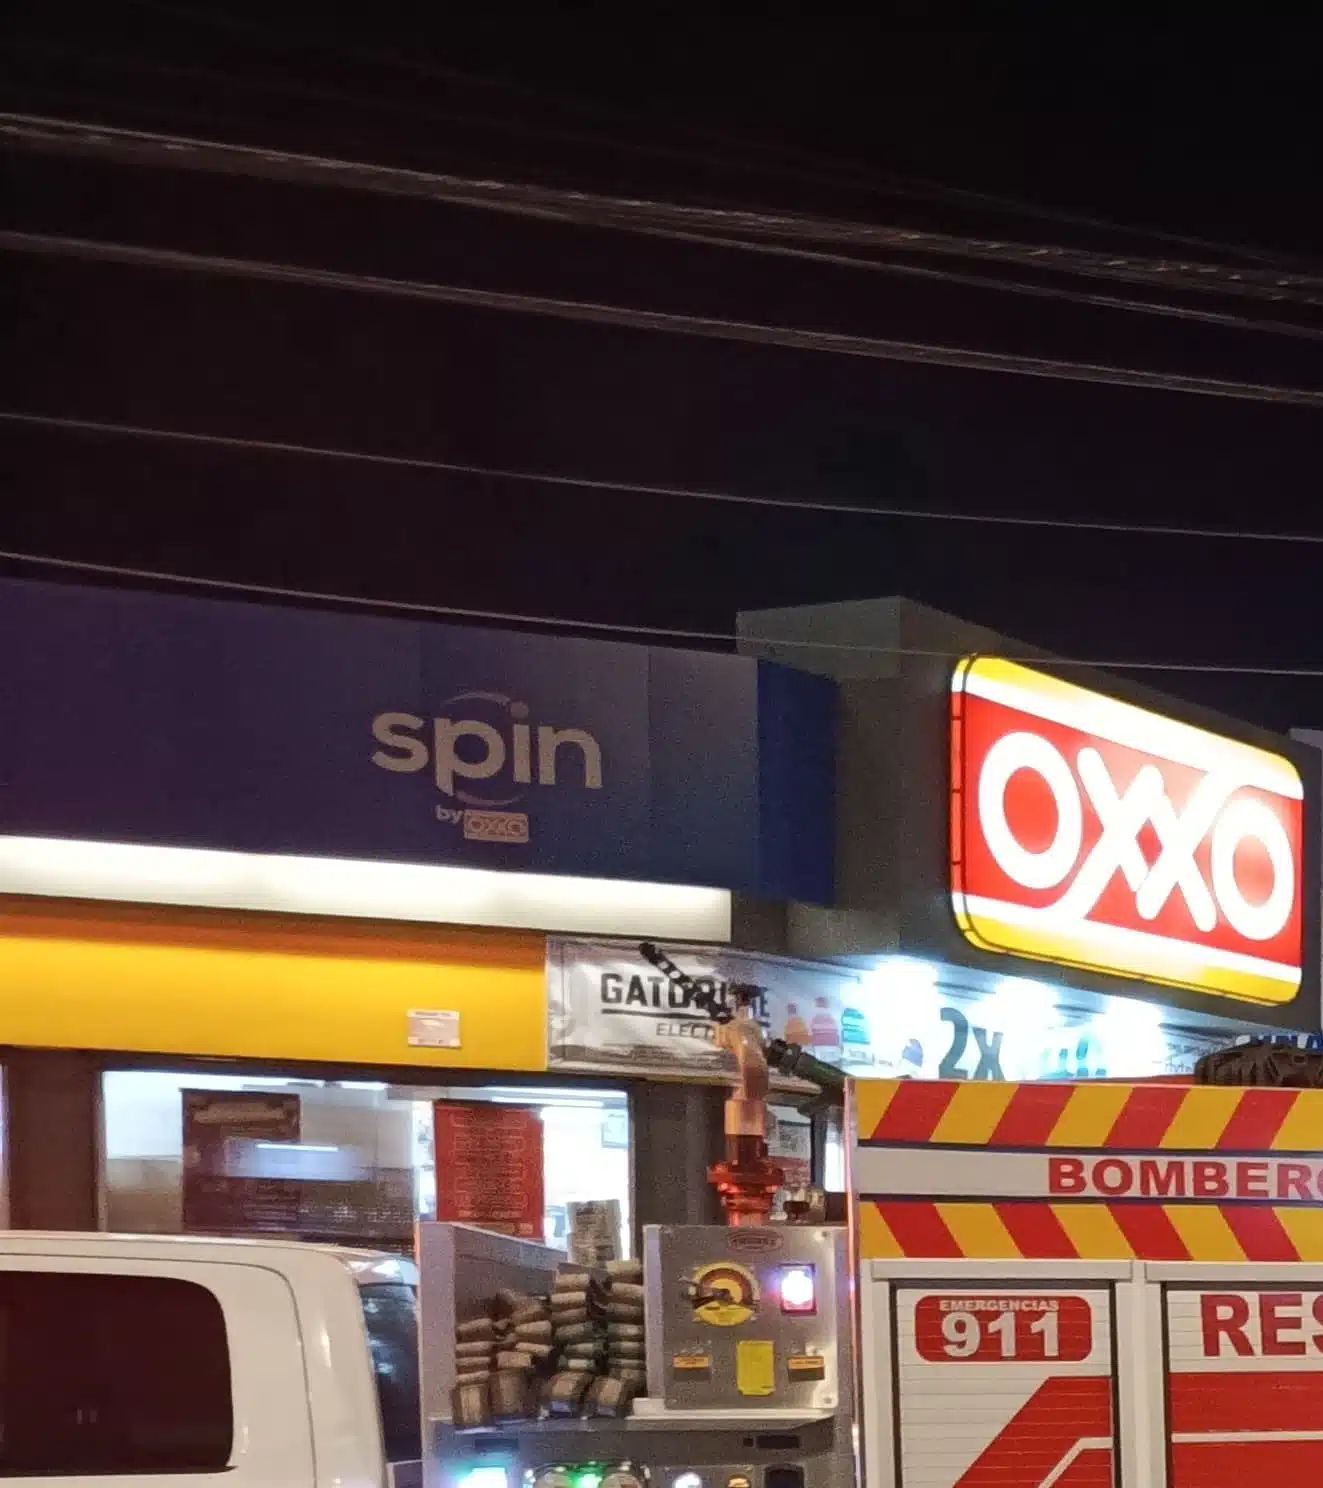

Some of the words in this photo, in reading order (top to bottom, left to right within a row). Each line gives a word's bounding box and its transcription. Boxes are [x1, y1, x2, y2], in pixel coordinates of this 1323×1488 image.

[371, 700, 602, 797] spin
[436, 804, 463, 824] by
[978, 731, 1295, 941] OXXO
[939, 1299, 1060, 1312] EMERGENCIAS
[941, 1310, 1060, 1358] 911
